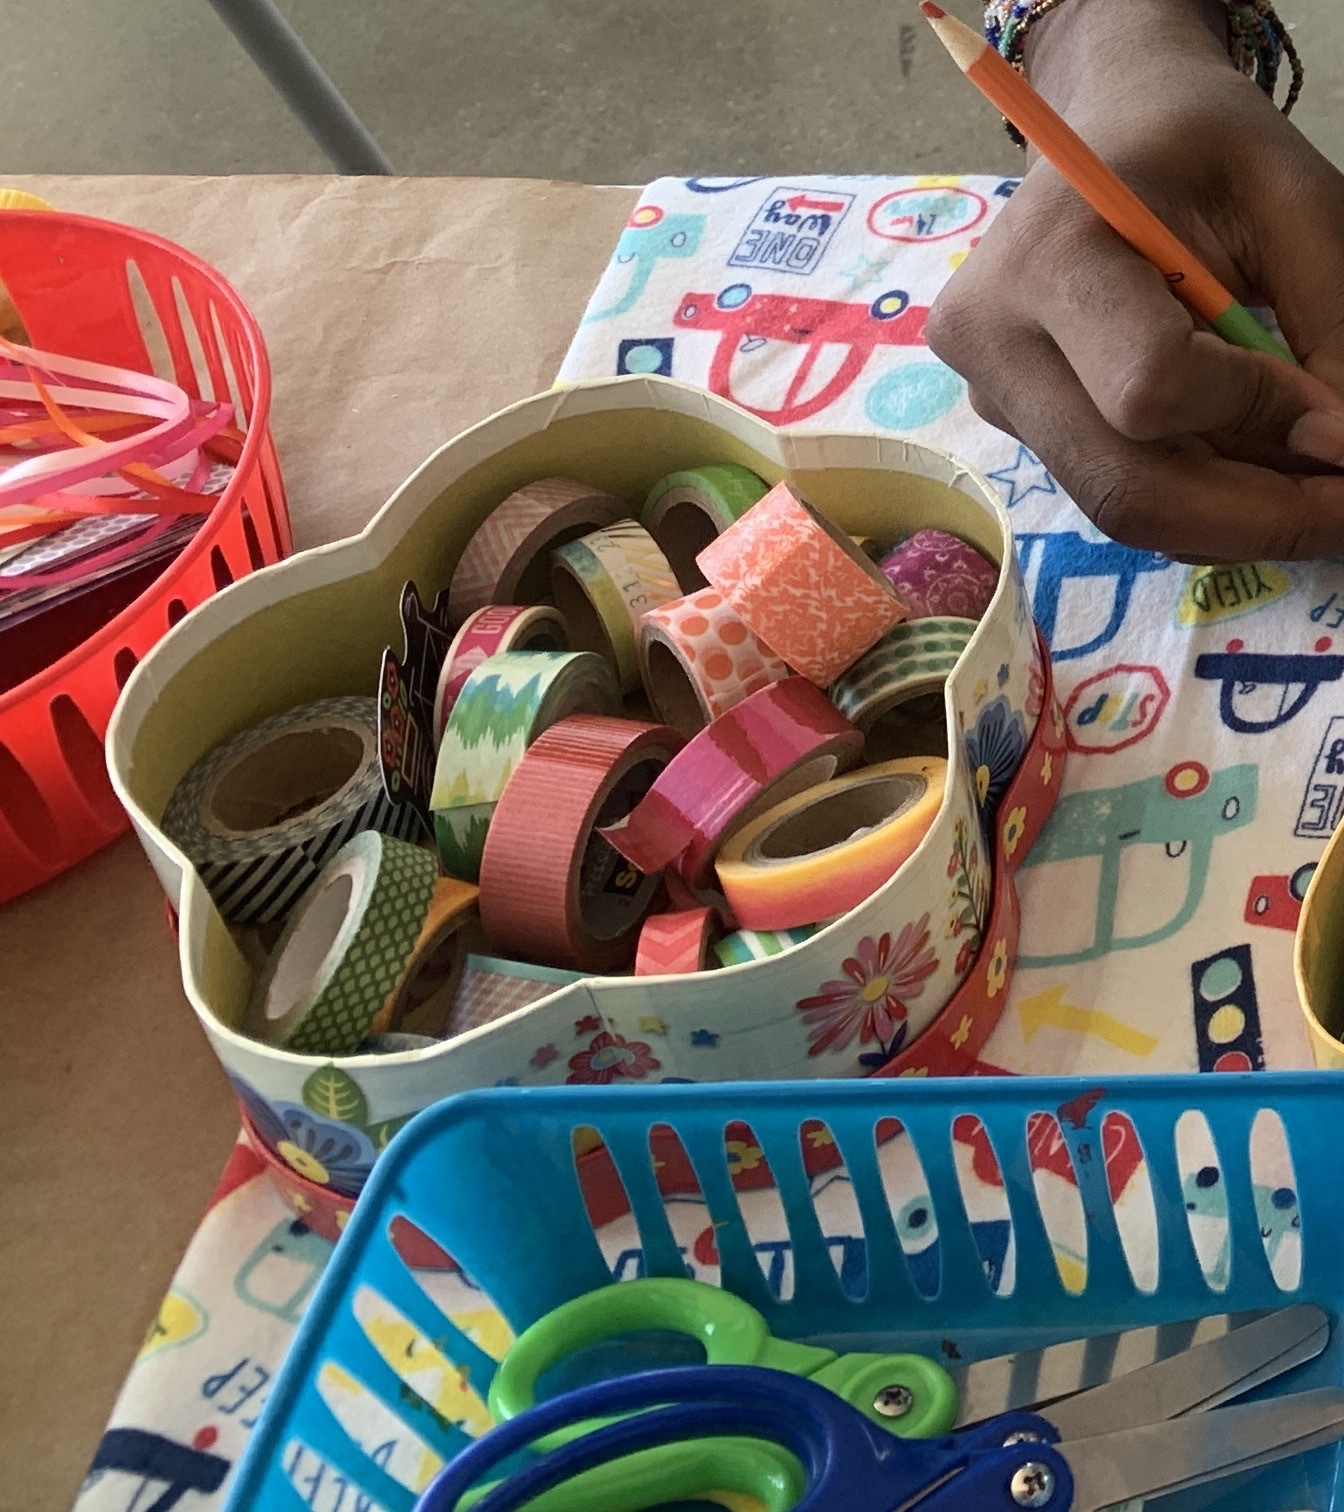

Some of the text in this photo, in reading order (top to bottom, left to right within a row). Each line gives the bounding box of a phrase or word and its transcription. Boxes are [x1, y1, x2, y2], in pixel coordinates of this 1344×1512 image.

[763, 199, 833, 238] Way
[735, 229, 821, 269] ONE
[1193, 563, 1274, 613] YIELD
[1077, 692, 1156, 732] STOP
